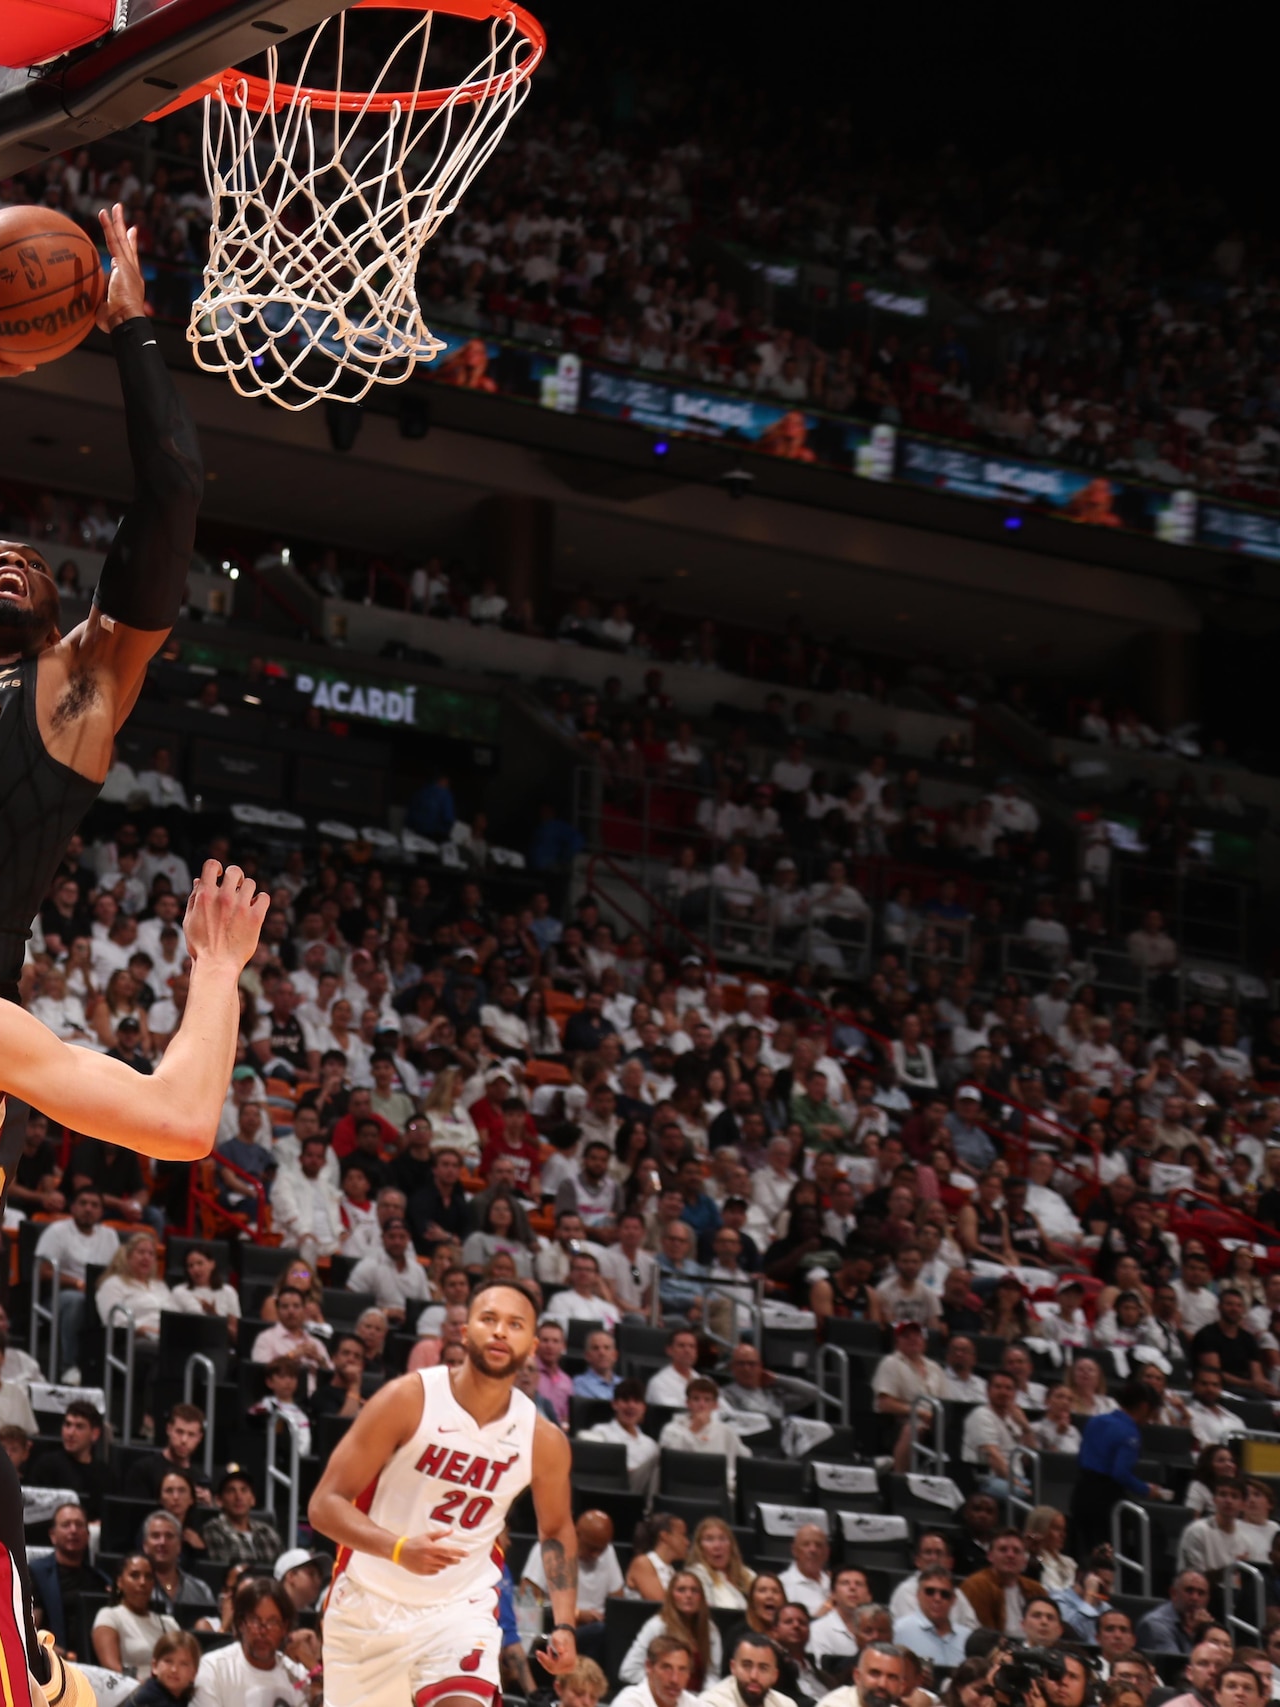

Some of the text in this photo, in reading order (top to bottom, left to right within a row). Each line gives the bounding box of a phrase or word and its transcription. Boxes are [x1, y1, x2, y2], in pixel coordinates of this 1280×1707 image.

[294, 672, 418, 724] BACARDÍ
[414, 1443, 520, 1492] HEAT
[429, 1489, 494, 1530] 20
